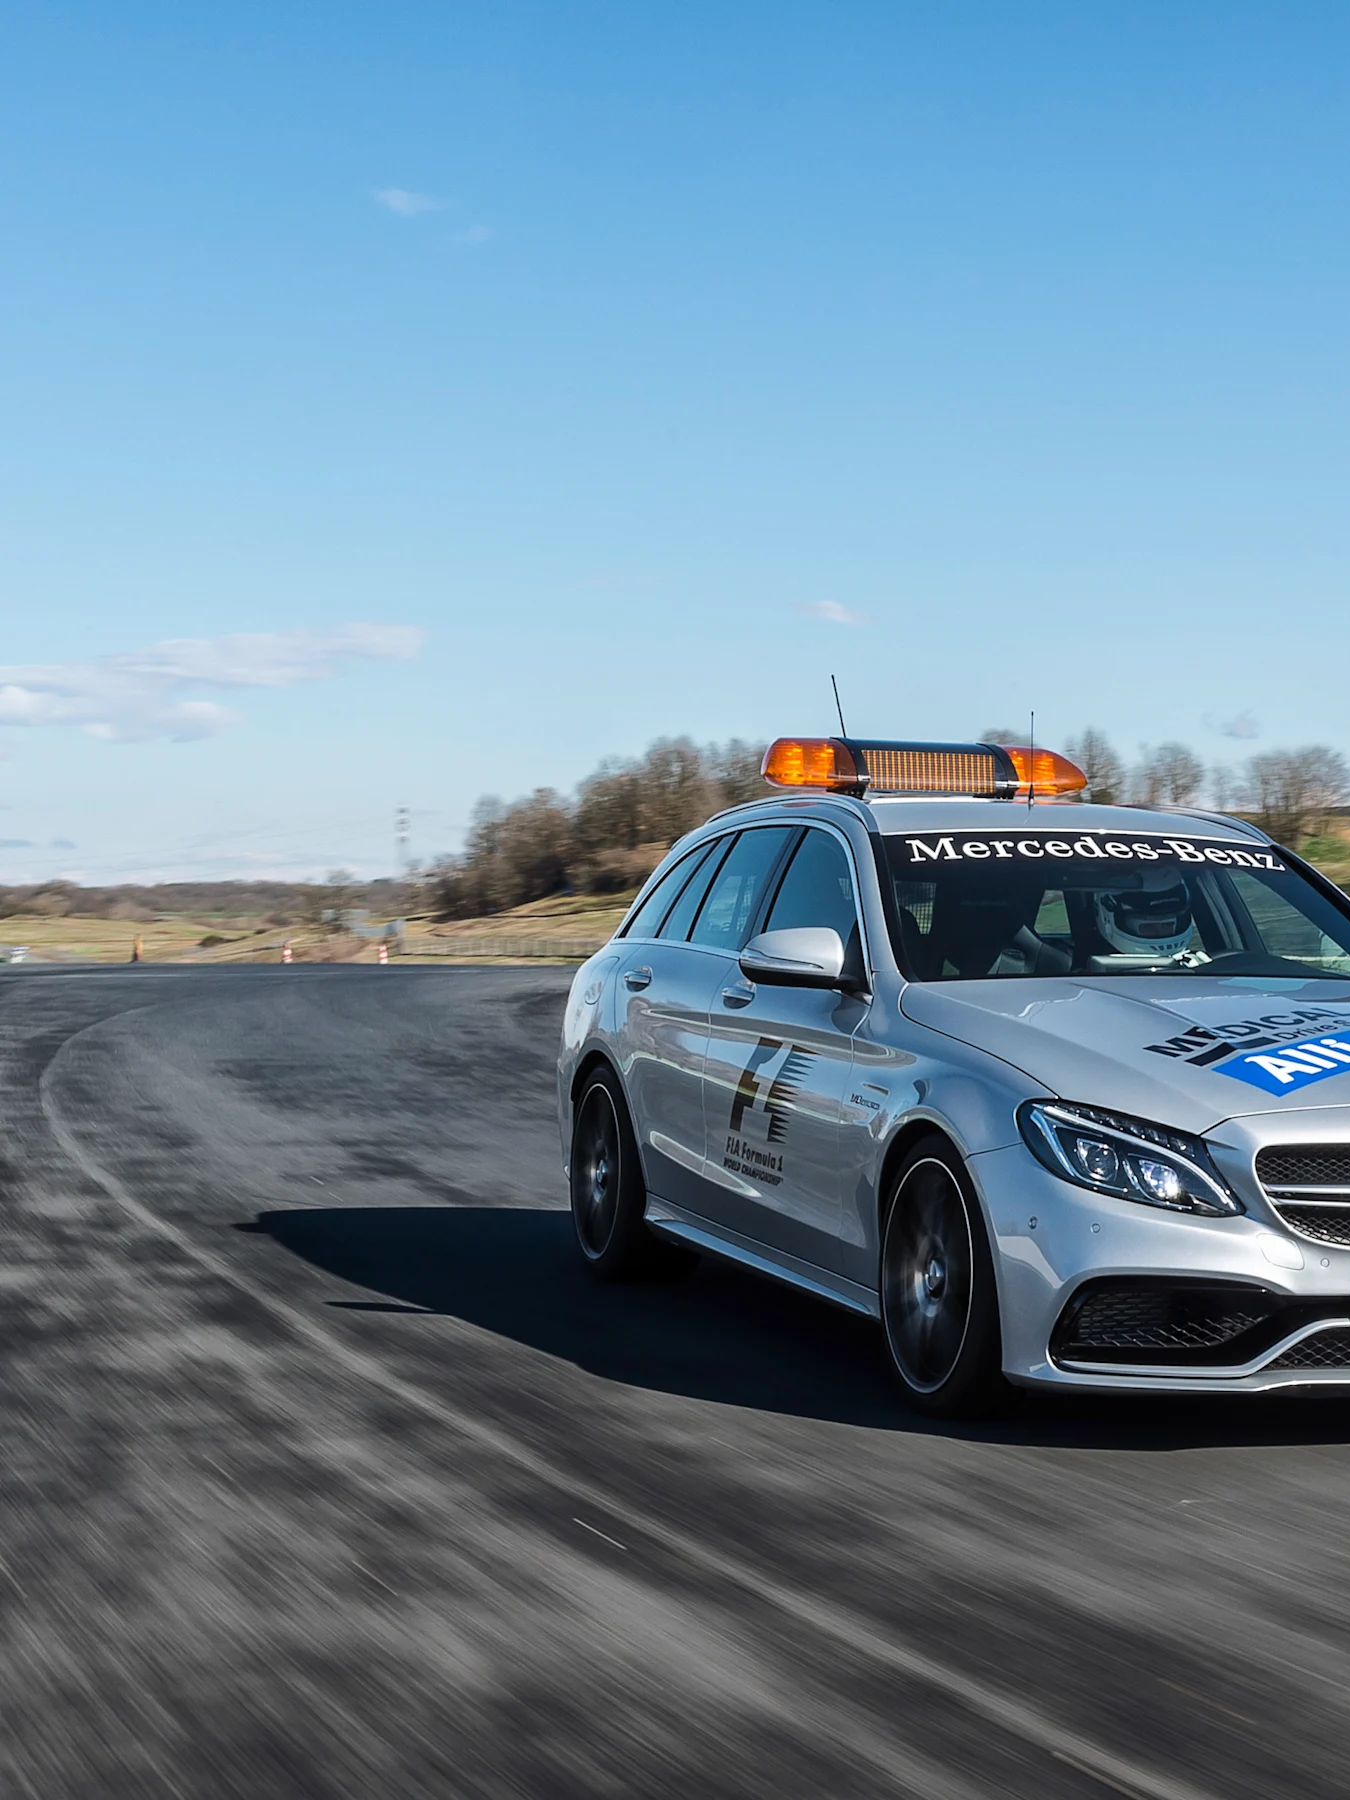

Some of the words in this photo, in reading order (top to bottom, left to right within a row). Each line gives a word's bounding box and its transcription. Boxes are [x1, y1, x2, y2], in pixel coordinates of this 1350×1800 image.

[905, 836, 1286, 872] Mercedes-Benz
[1272, 1019, 1338, 1041] Drive
[725, 1135, 740, 1157] FIA
[741, 1141, 776, 1170] Formula
[777, 1155, 783, 1173] 1
